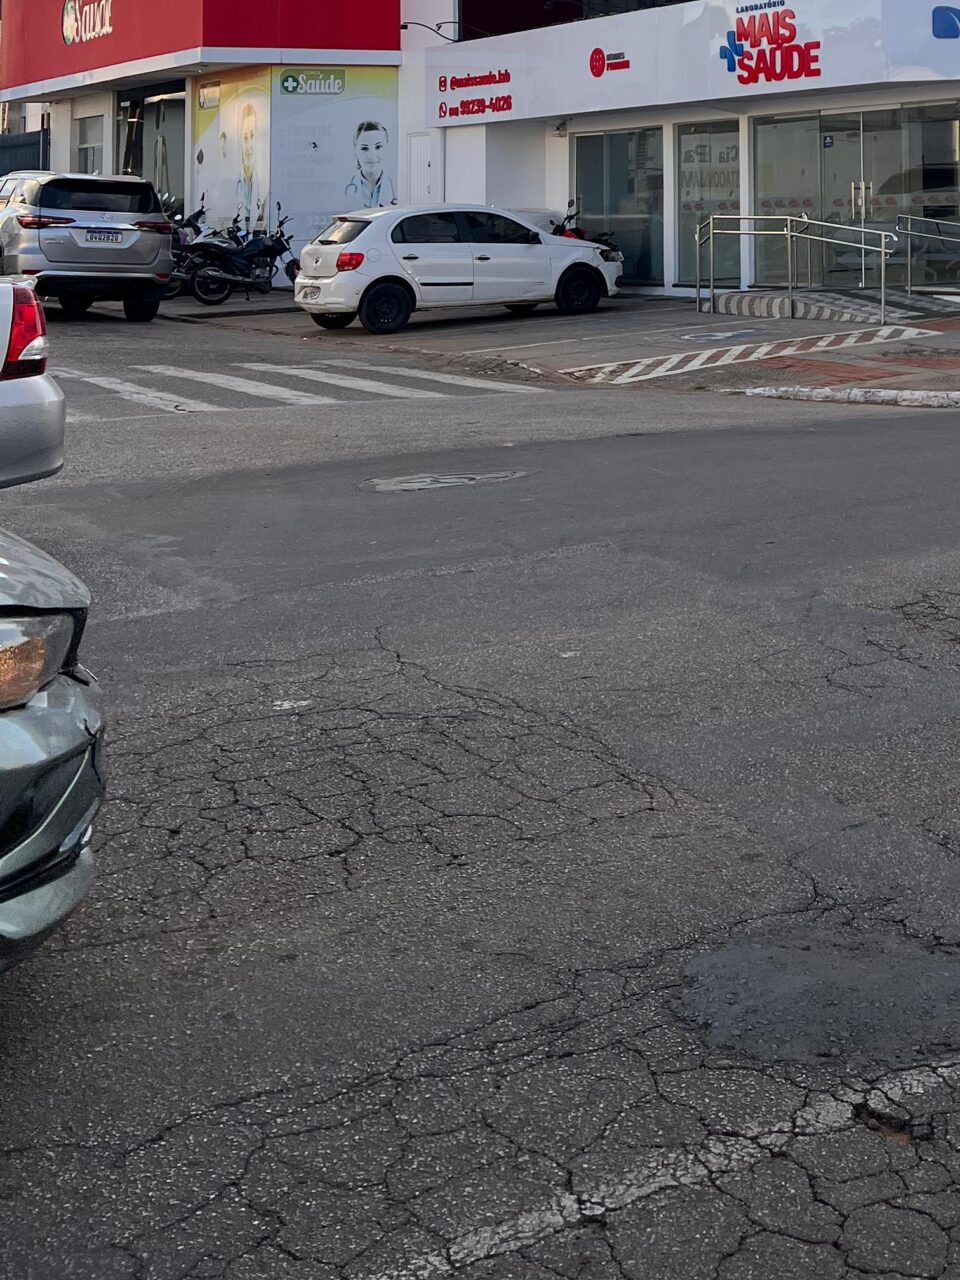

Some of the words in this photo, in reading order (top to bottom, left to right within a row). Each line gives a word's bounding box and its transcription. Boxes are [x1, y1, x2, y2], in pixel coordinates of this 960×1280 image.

[736, 0, 785, 14] LABORATÓRIO
[736, 8, 797, 48] MAIS
[737, 40, 821, 85] SAÚDE
[297, 73, 343, 94] Saúde
